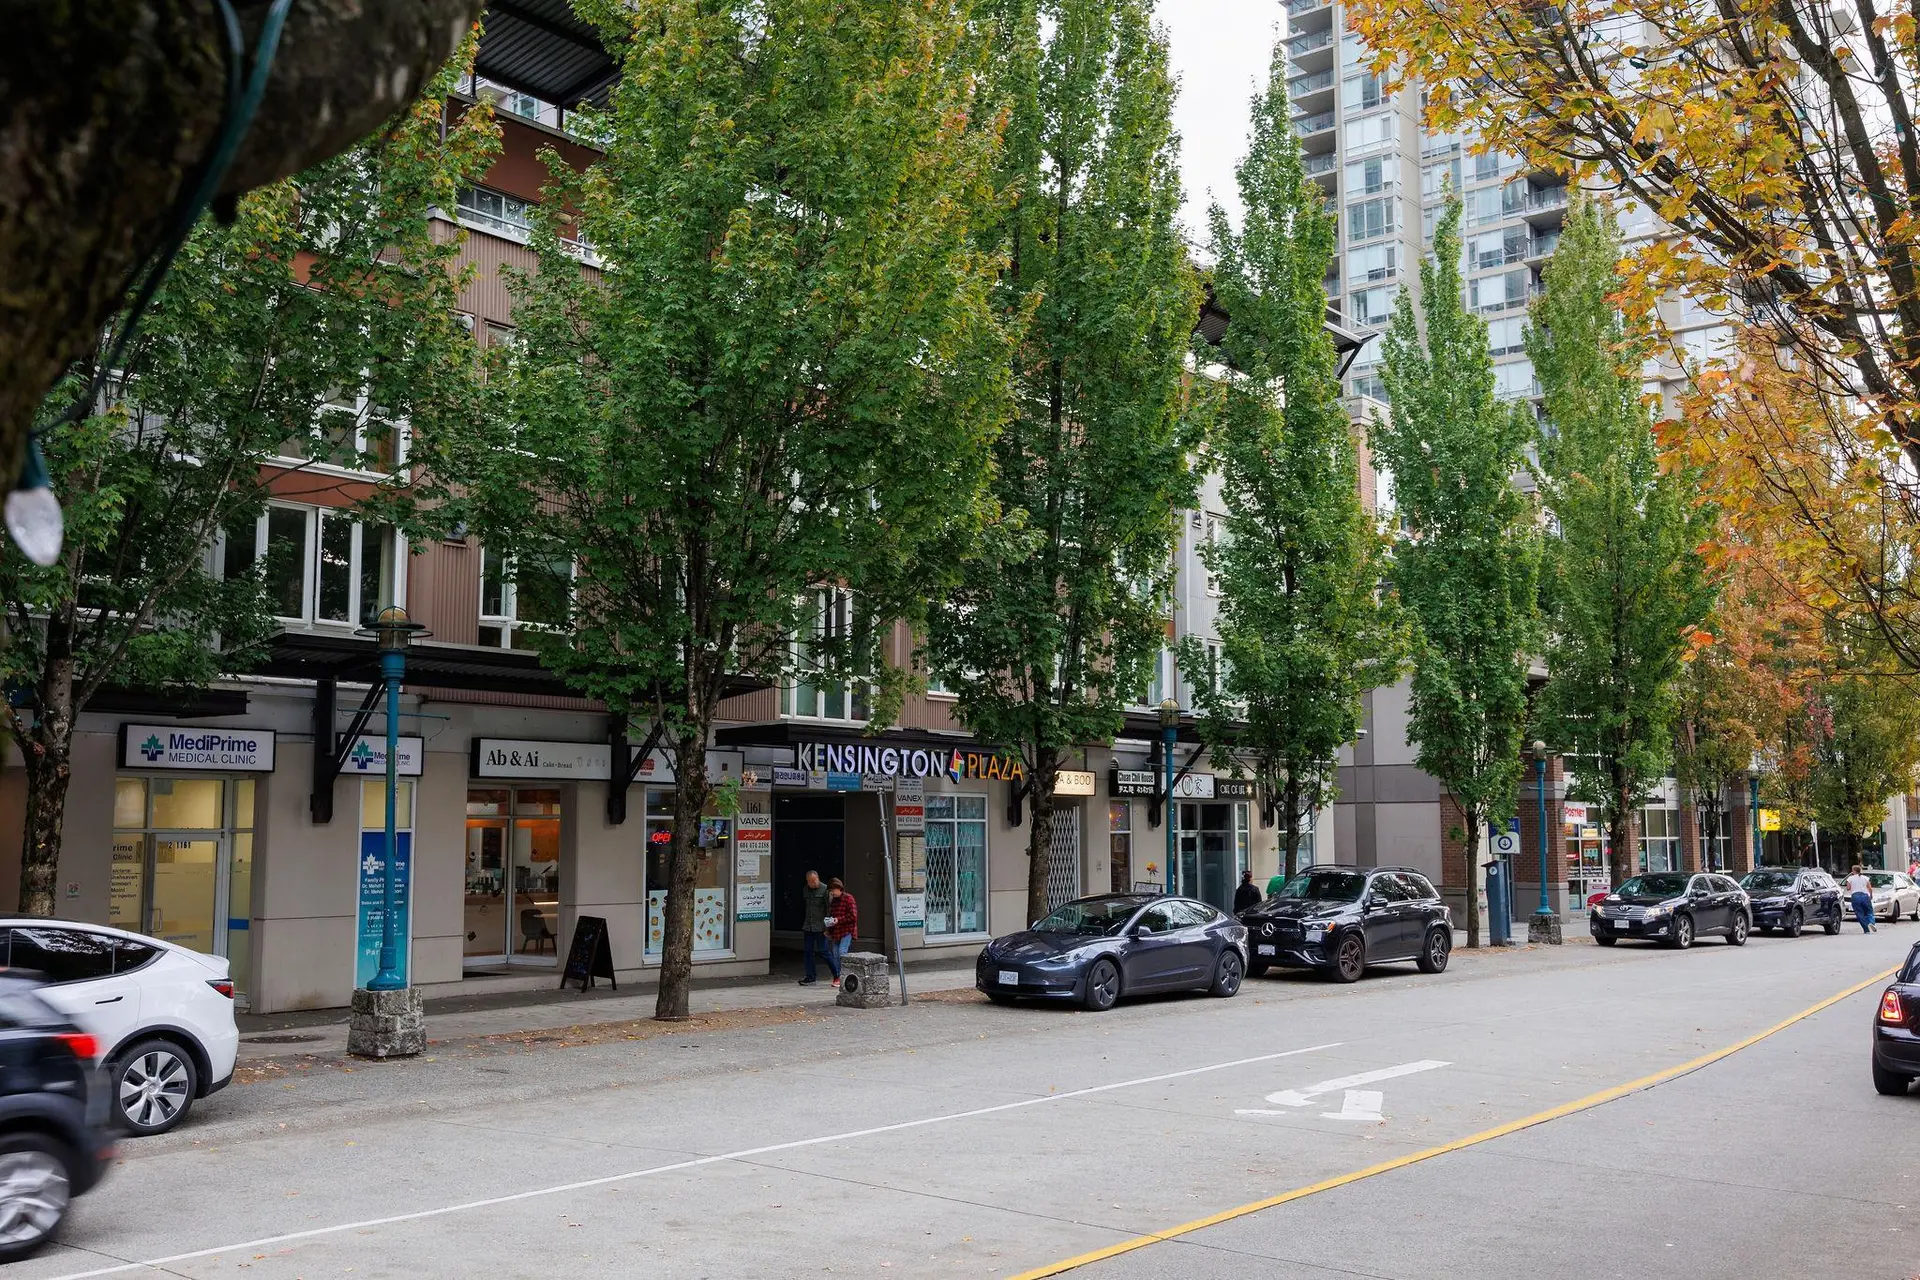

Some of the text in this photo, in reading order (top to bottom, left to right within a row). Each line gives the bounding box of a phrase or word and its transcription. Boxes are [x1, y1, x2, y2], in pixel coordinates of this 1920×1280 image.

[169, 734, 257, 752] MediPrime
[168, 753, 257, 765] MEDICAL CLINIC
[486, 749, 540, 767] Ab & Ai
[798, 743, 945, 777] KENSINGTON
[968, 753, 1025, 781] PLAZA
[1074, 774, 1092, 786] BOO
[746, 802, 761, 813] 1161
[740, 817, 769, 825] VANEX
